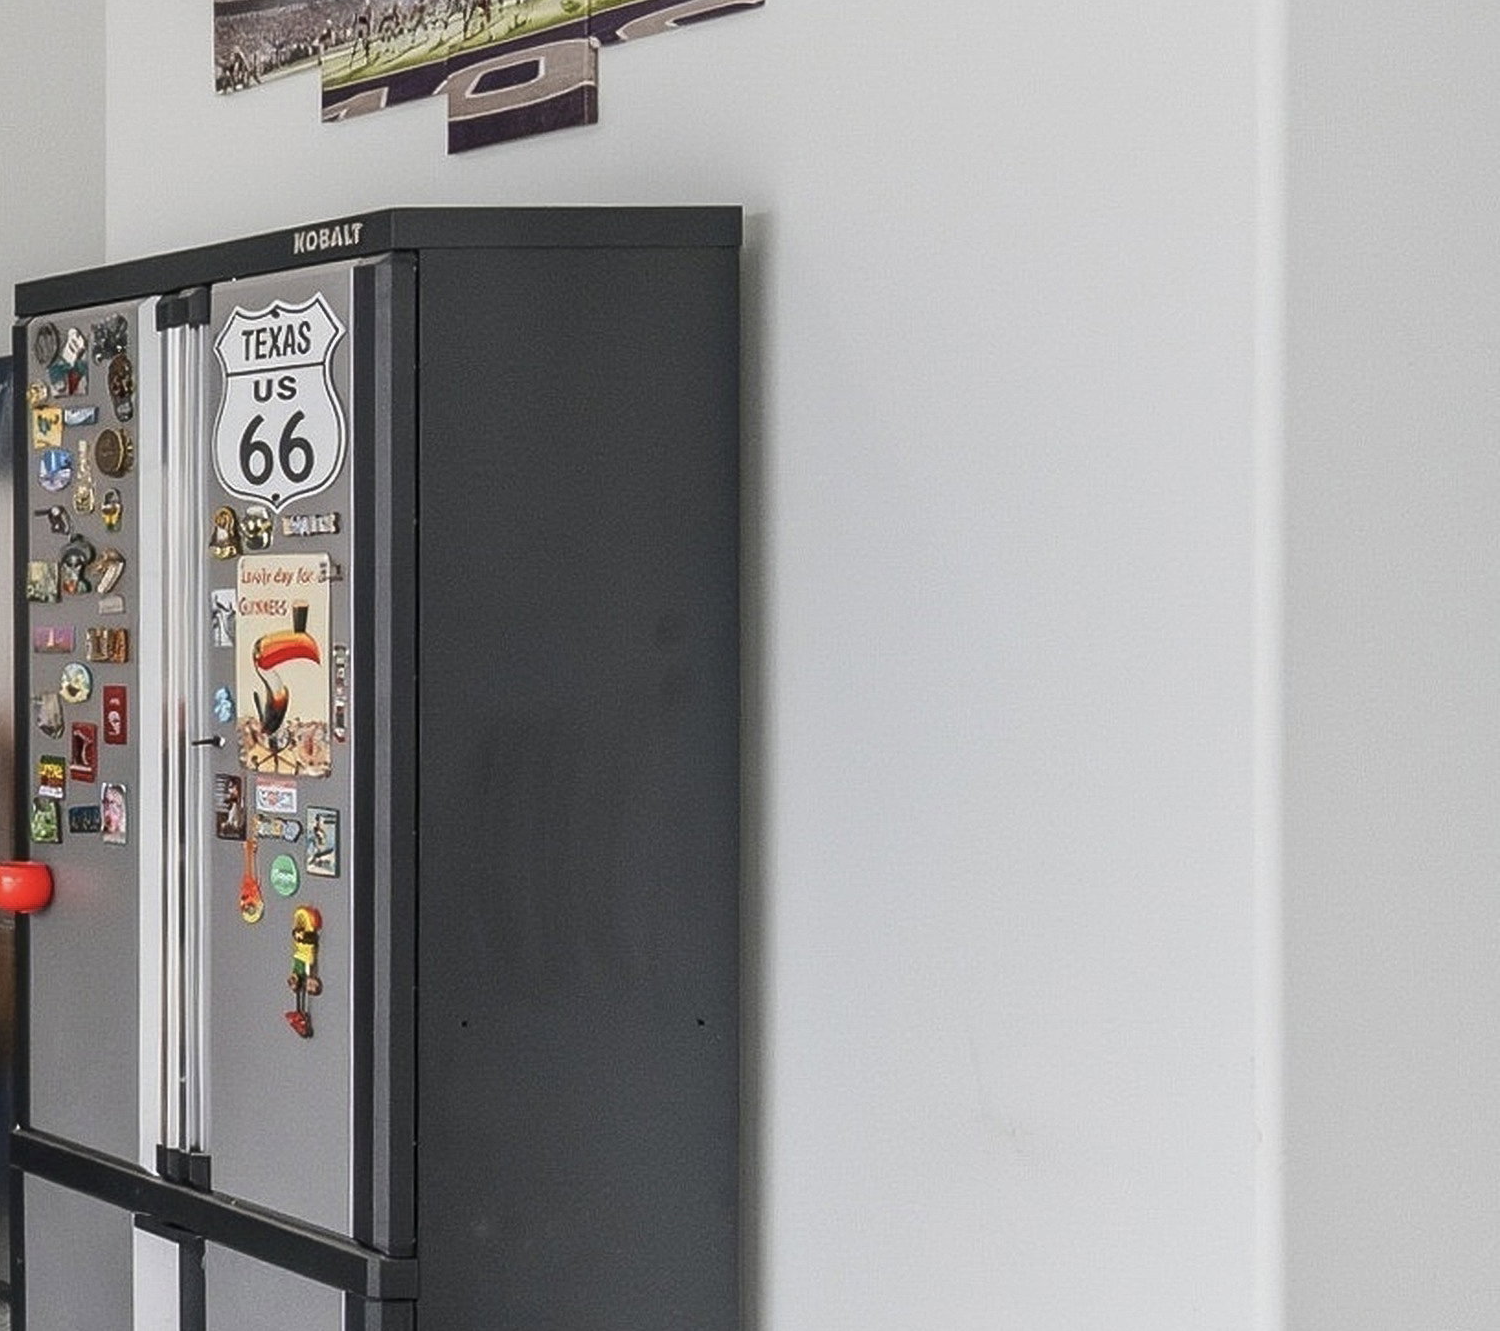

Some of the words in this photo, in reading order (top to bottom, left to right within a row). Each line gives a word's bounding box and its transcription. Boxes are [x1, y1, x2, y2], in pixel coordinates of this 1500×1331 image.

[293, 222, 363, 254] KOBALT
[240, 320, 312, 360] TEXAS
[252, 374, 298, 402] US
[238, 412, 315, 486] 66
